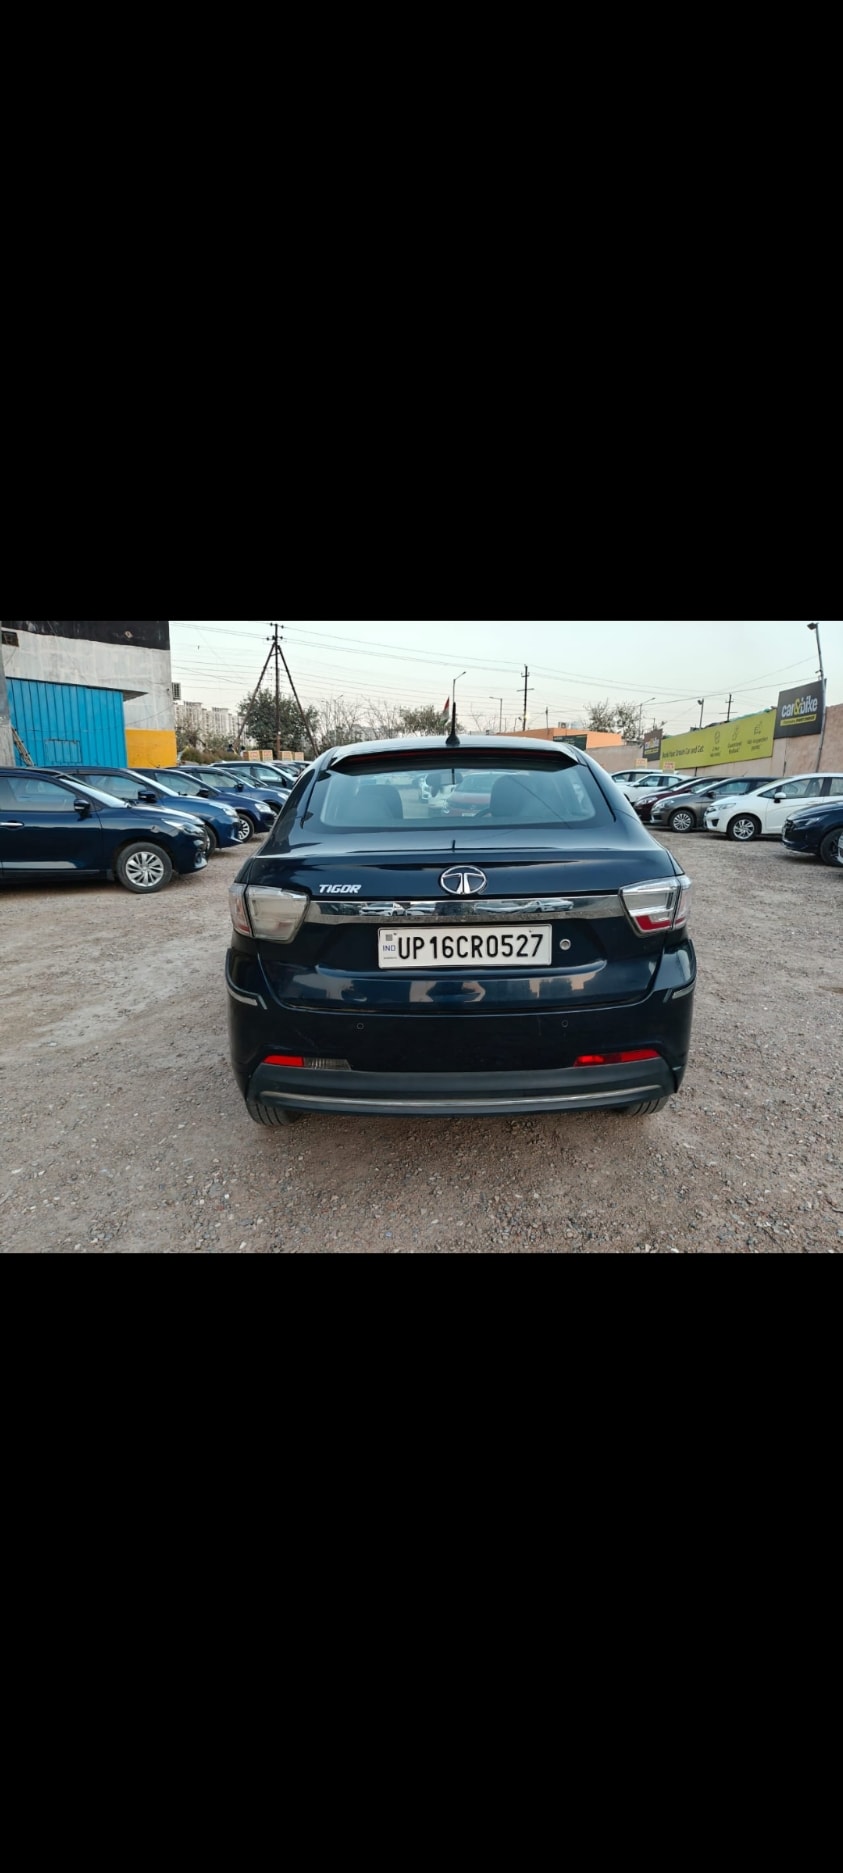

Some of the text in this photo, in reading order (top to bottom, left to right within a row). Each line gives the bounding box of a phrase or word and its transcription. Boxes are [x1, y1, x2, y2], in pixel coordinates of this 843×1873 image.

[781, 695, 818, 717] car&bike
[319, 884, 362, 894] TIGOR
[398, 934, 543, 960] UP16CR0527
